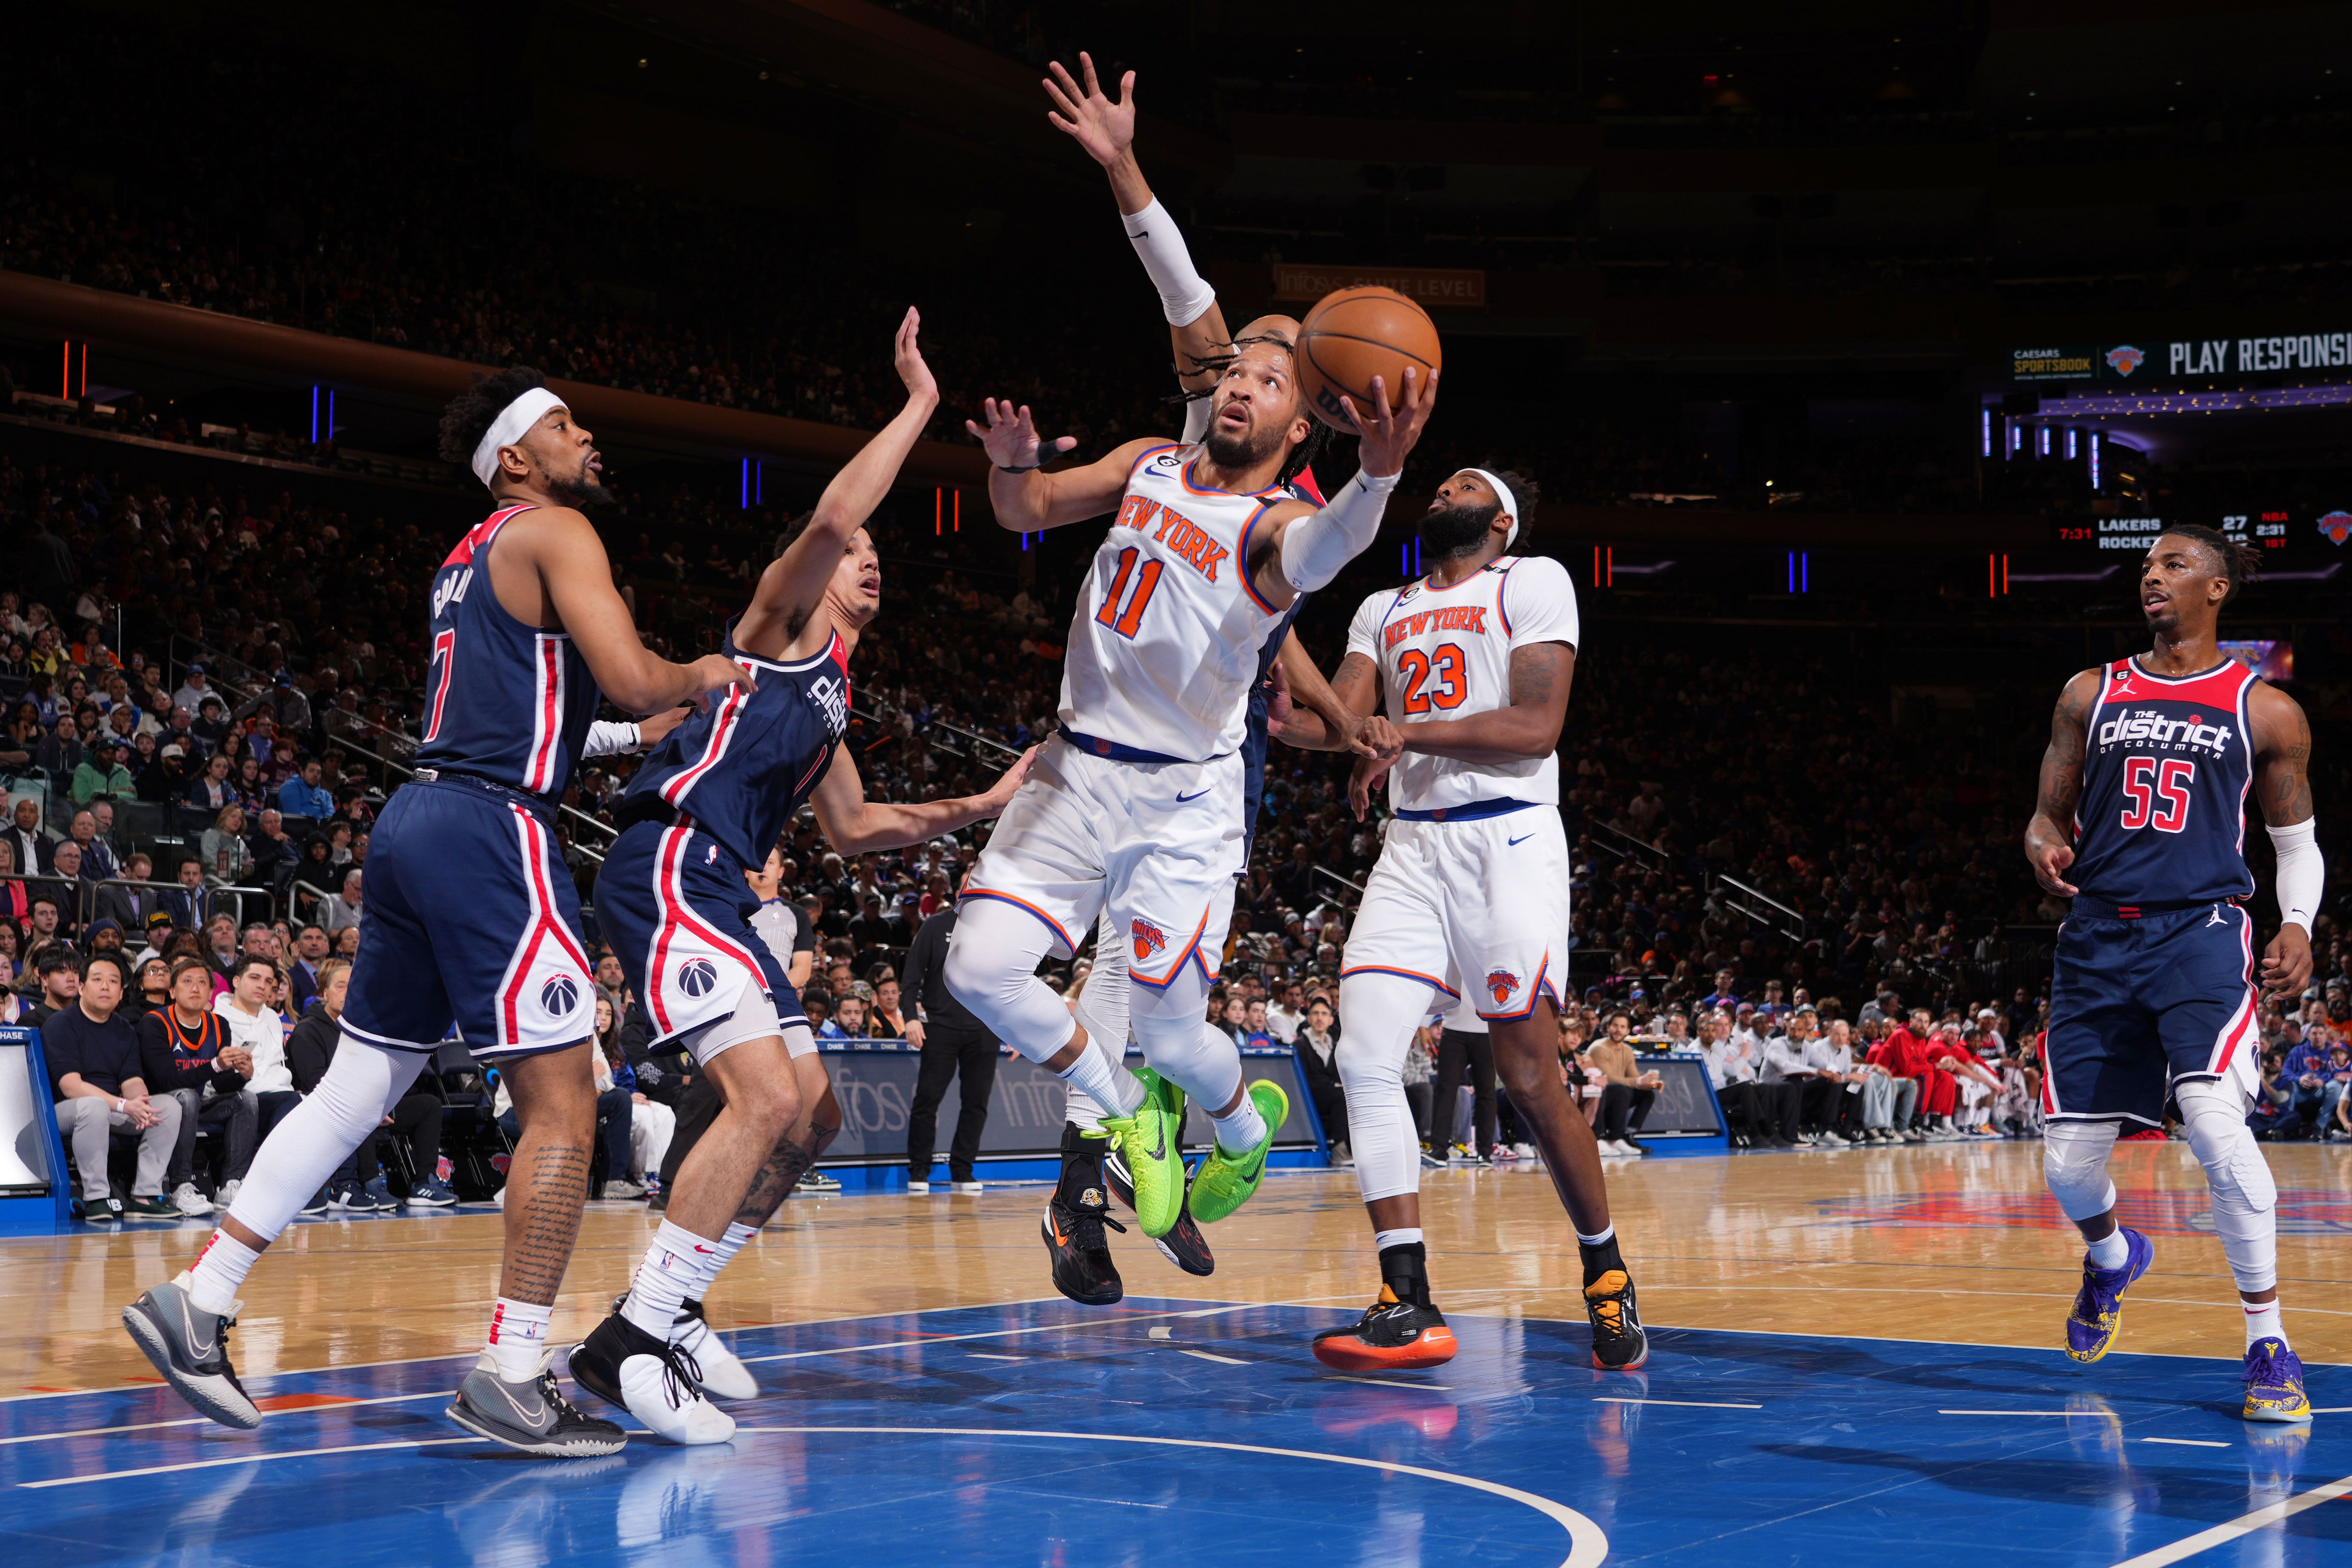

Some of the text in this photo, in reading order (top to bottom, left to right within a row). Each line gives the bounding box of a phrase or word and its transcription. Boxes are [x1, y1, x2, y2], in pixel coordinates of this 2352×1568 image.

[1418, 280, 1476, 297] LEVEL
[2014, 349, 2060, 359] CAESARS
[2170, 332, 2352, 375] PLAY RESPONSI
[2014, 358, 2091, 373] SPORTSBOOK
[1160, 456, 1176, 466] 6
[2099, 516, 2248, 531] LAKERS 27
[2262, 512, 2288, 521] NBA
[2059, 528, 2091, 539] 7:31
[2256, 524, 2285, 536] 2:31
[1114, 495, 1230, 586] NEW YORK
[2265, 539, 2286, 548] 1ST
[1094, 545, 1165, 640] 11
[1384, 606, 1487, 653] NEW YORK
[1398, 642, 1467, 716] 23
[2116, 671, 2128, 680] 6
[423, 628, 455, 744] 7
[2135, 710, 2157, 719] THE
[2099, 708, 2232, 752] district
[2100, 740, 2222, 760] OF COLUMBIA
[2121, 756, 2195, 834] 55
[1132, 919, 1165, 949] KNICKS
[1488, 973, 1520, 989] KNICKS
